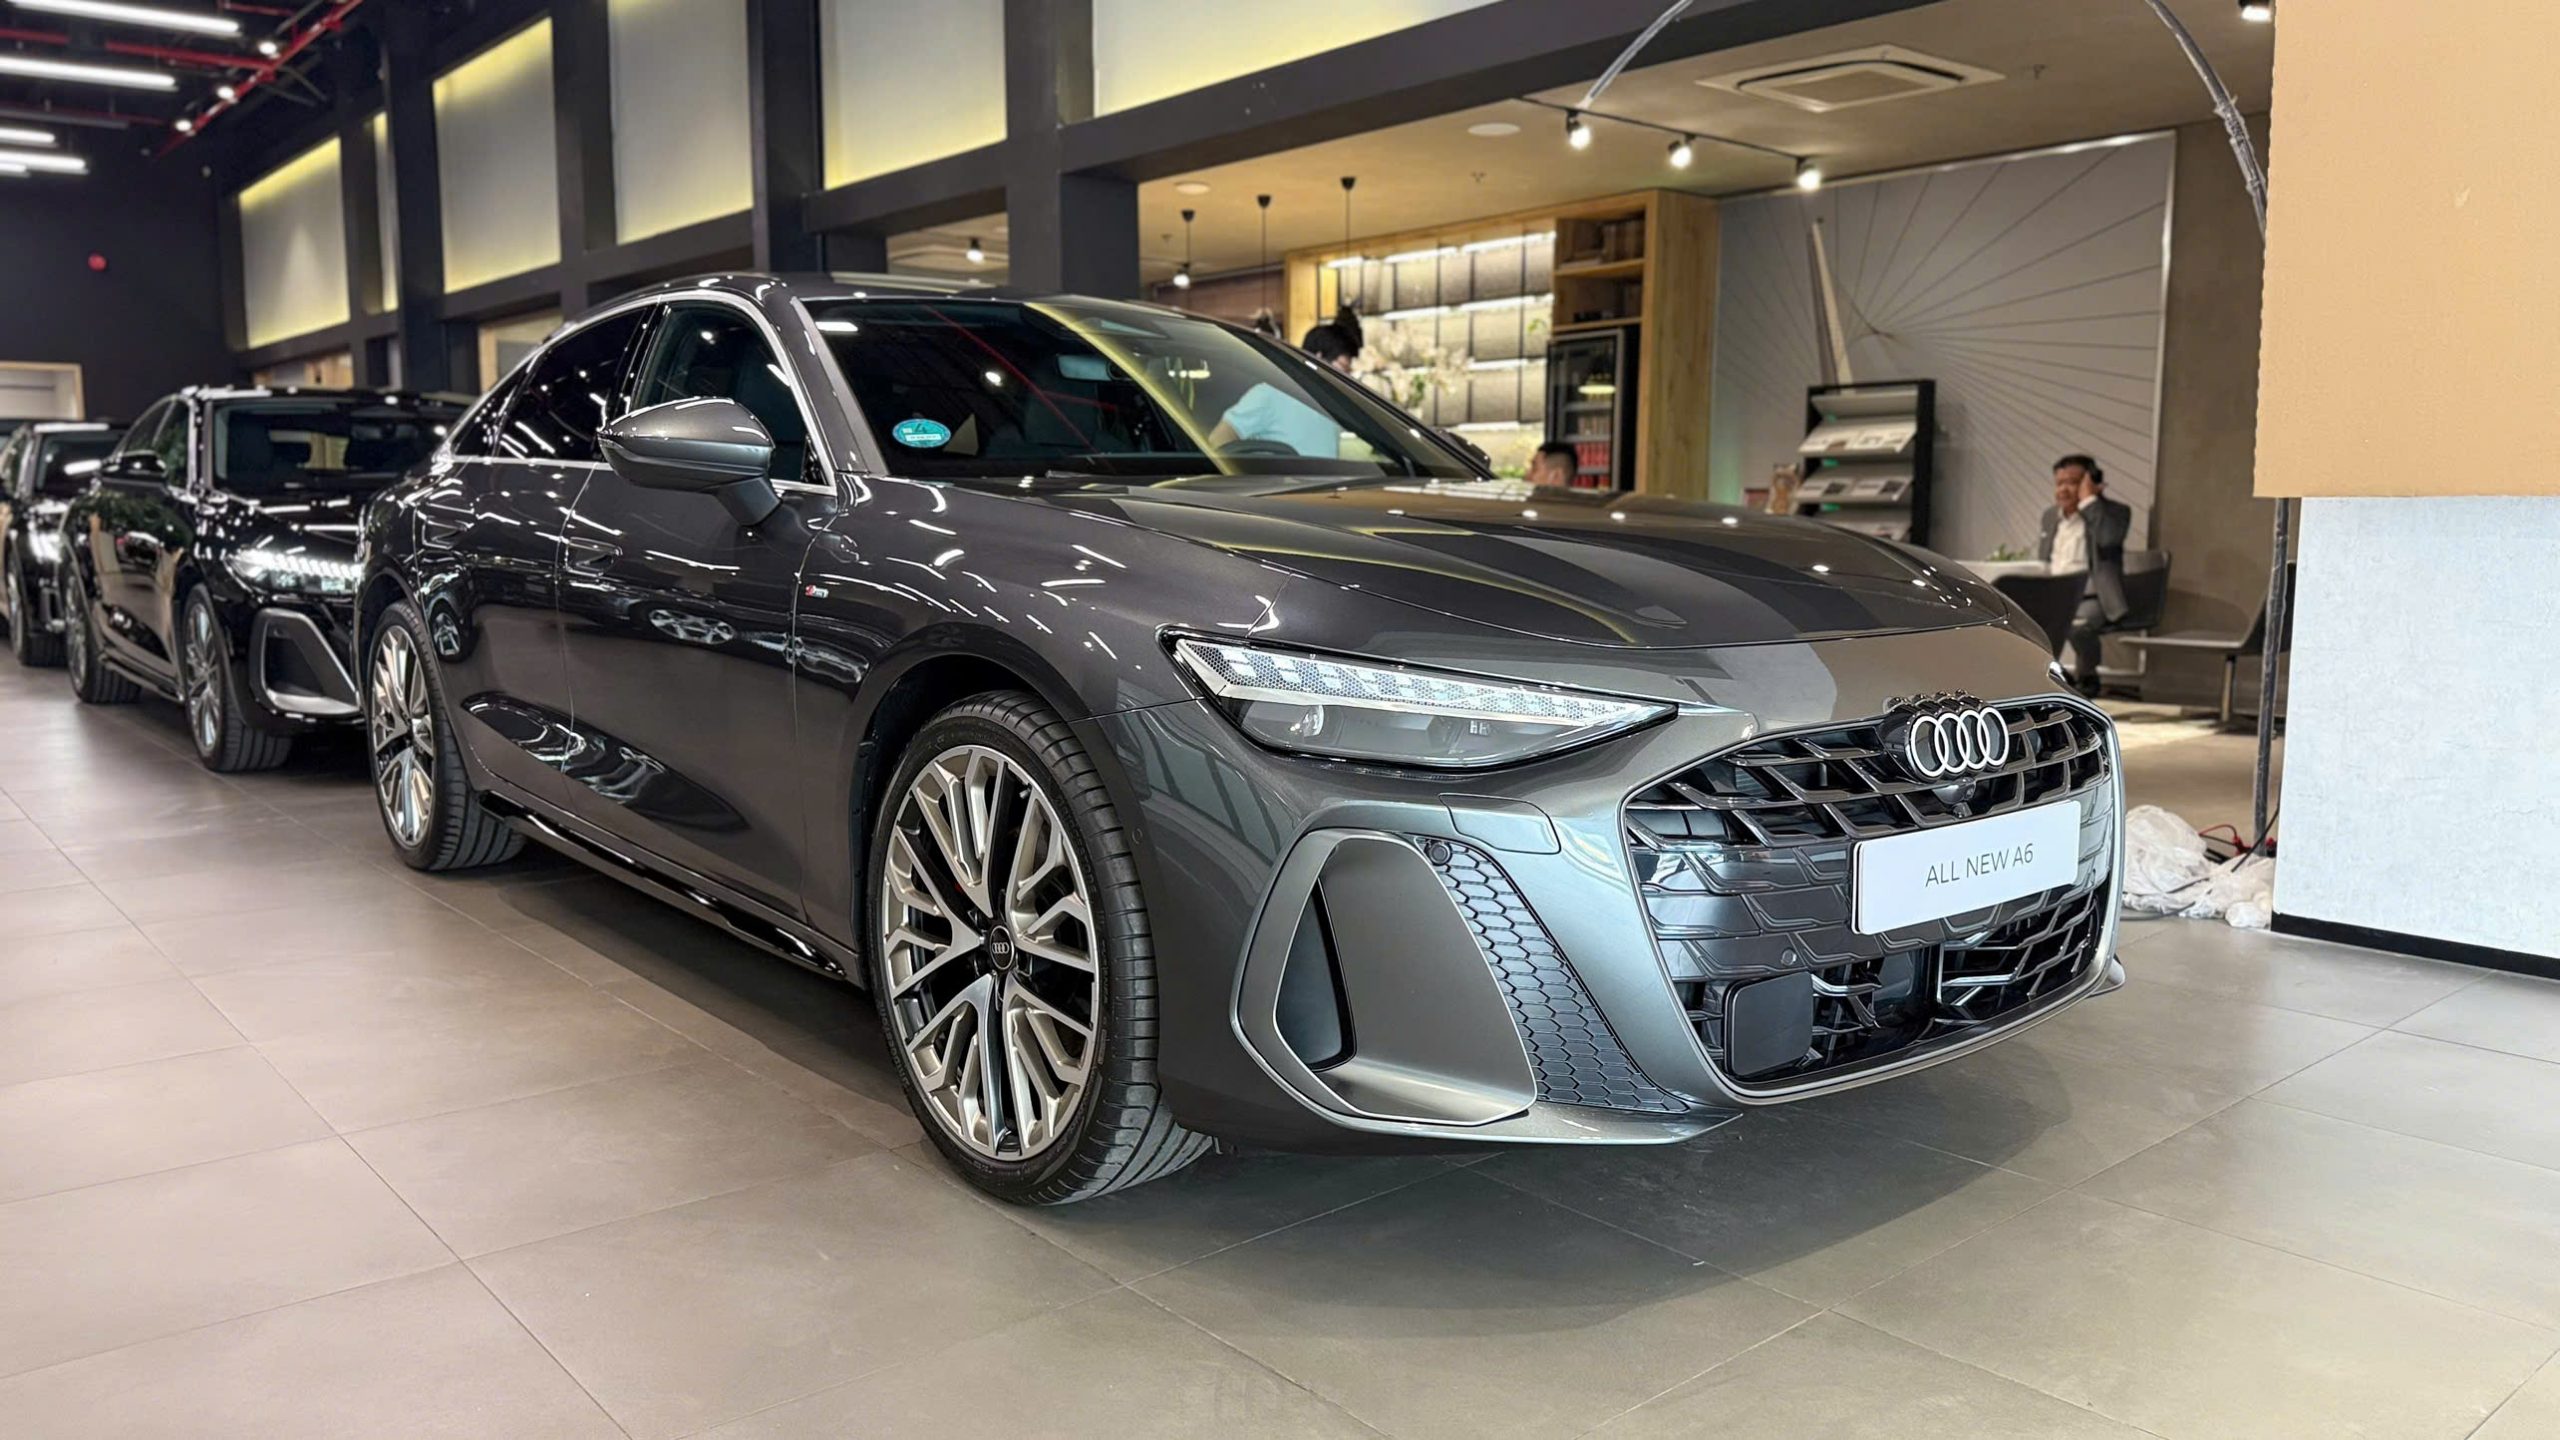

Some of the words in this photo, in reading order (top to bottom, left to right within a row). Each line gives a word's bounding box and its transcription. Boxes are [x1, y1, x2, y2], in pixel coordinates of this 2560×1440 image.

[1925, 861, 1960, 887] ALL
[1966, 848, 2010, 878] NEW
[2012, 843, 2034, 866] A6
